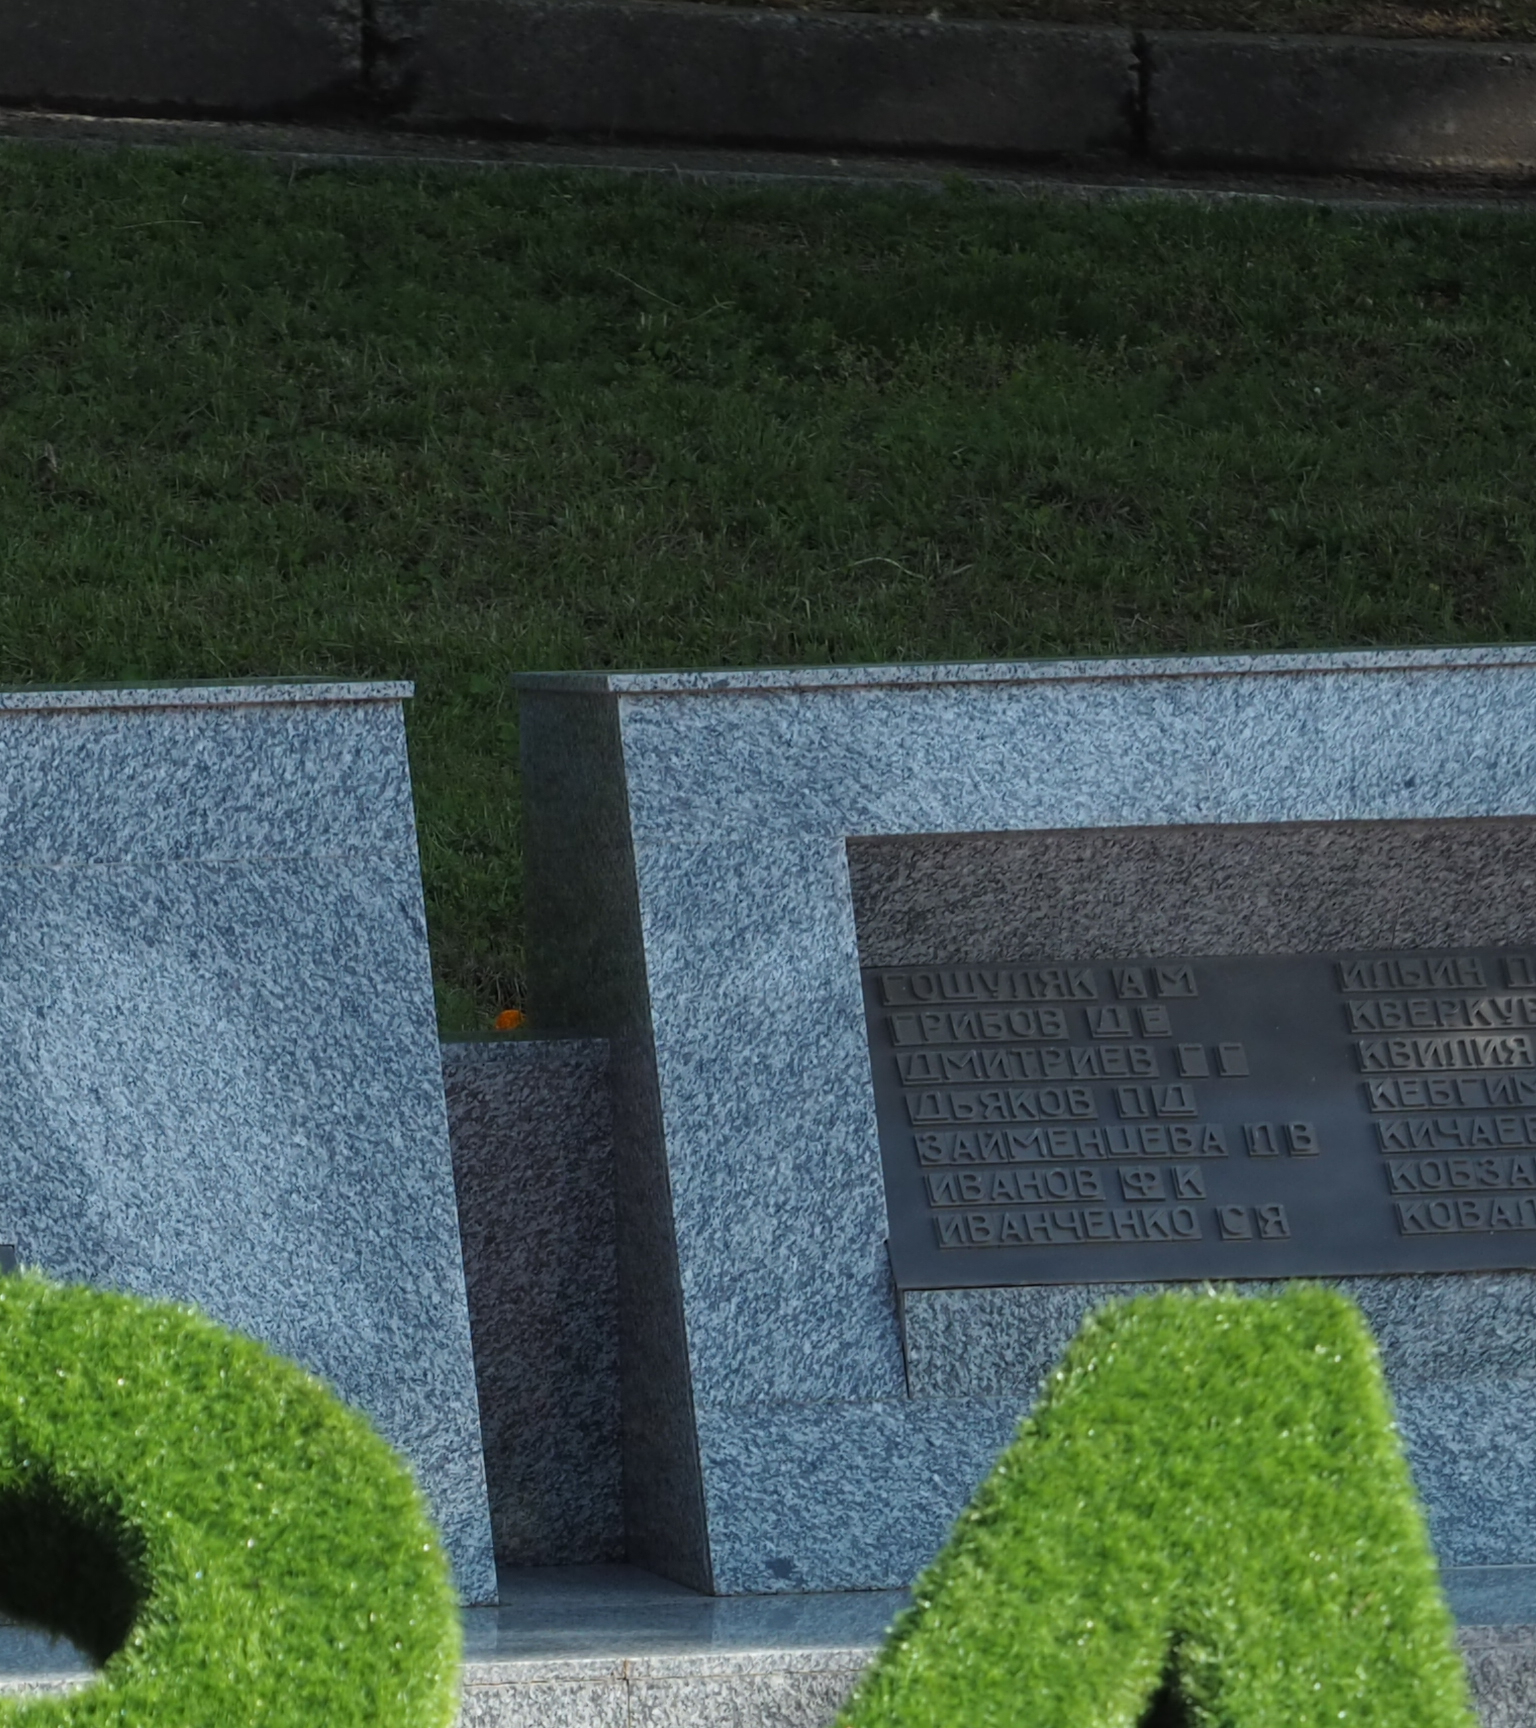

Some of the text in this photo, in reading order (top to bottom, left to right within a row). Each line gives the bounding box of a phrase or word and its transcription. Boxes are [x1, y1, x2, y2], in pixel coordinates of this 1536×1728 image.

[1341, 959, 1483, 989] ИЛЬИН
[892, 1010, 1066, 1043] ГРИБОВ
[904, 1047, 1156, 1082] ДМИТРИЕВ
[1360, 1036, 1532, 1069] КВИЛИЯ
[914, 1087, 1095, 1122] ДЬЯКОВ
[921, 1125, 1225, 1163] ЗАЙМЕНЦЕВА
[928, 1168, 1102, 1204] ИВАНОВ
[938, 1208, 1199, 1246] ИВАНЧЕНКО
